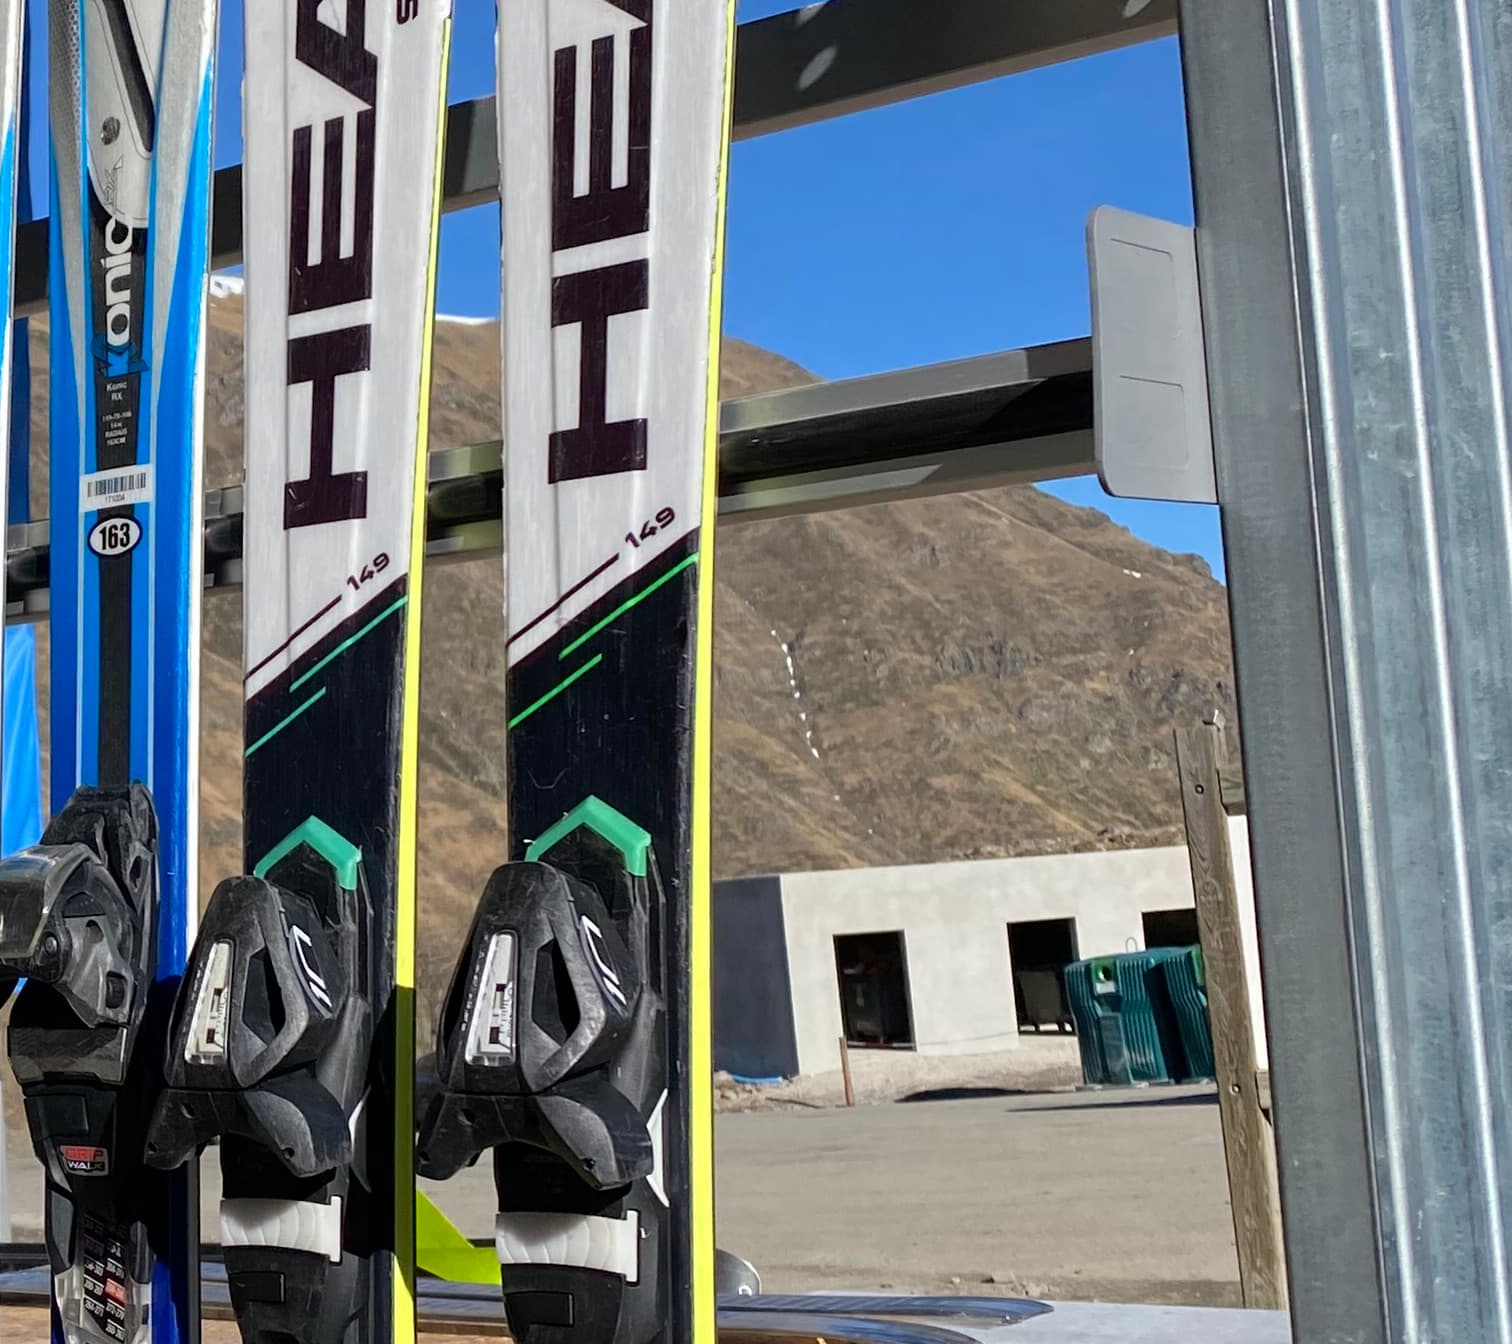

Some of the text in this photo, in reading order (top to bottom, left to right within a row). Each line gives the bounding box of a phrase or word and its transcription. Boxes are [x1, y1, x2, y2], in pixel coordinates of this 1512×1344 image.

[99, 523, 130, 549] 163
[622, 504, 676, 550] 149
[346, 549, 392, 591] 149
